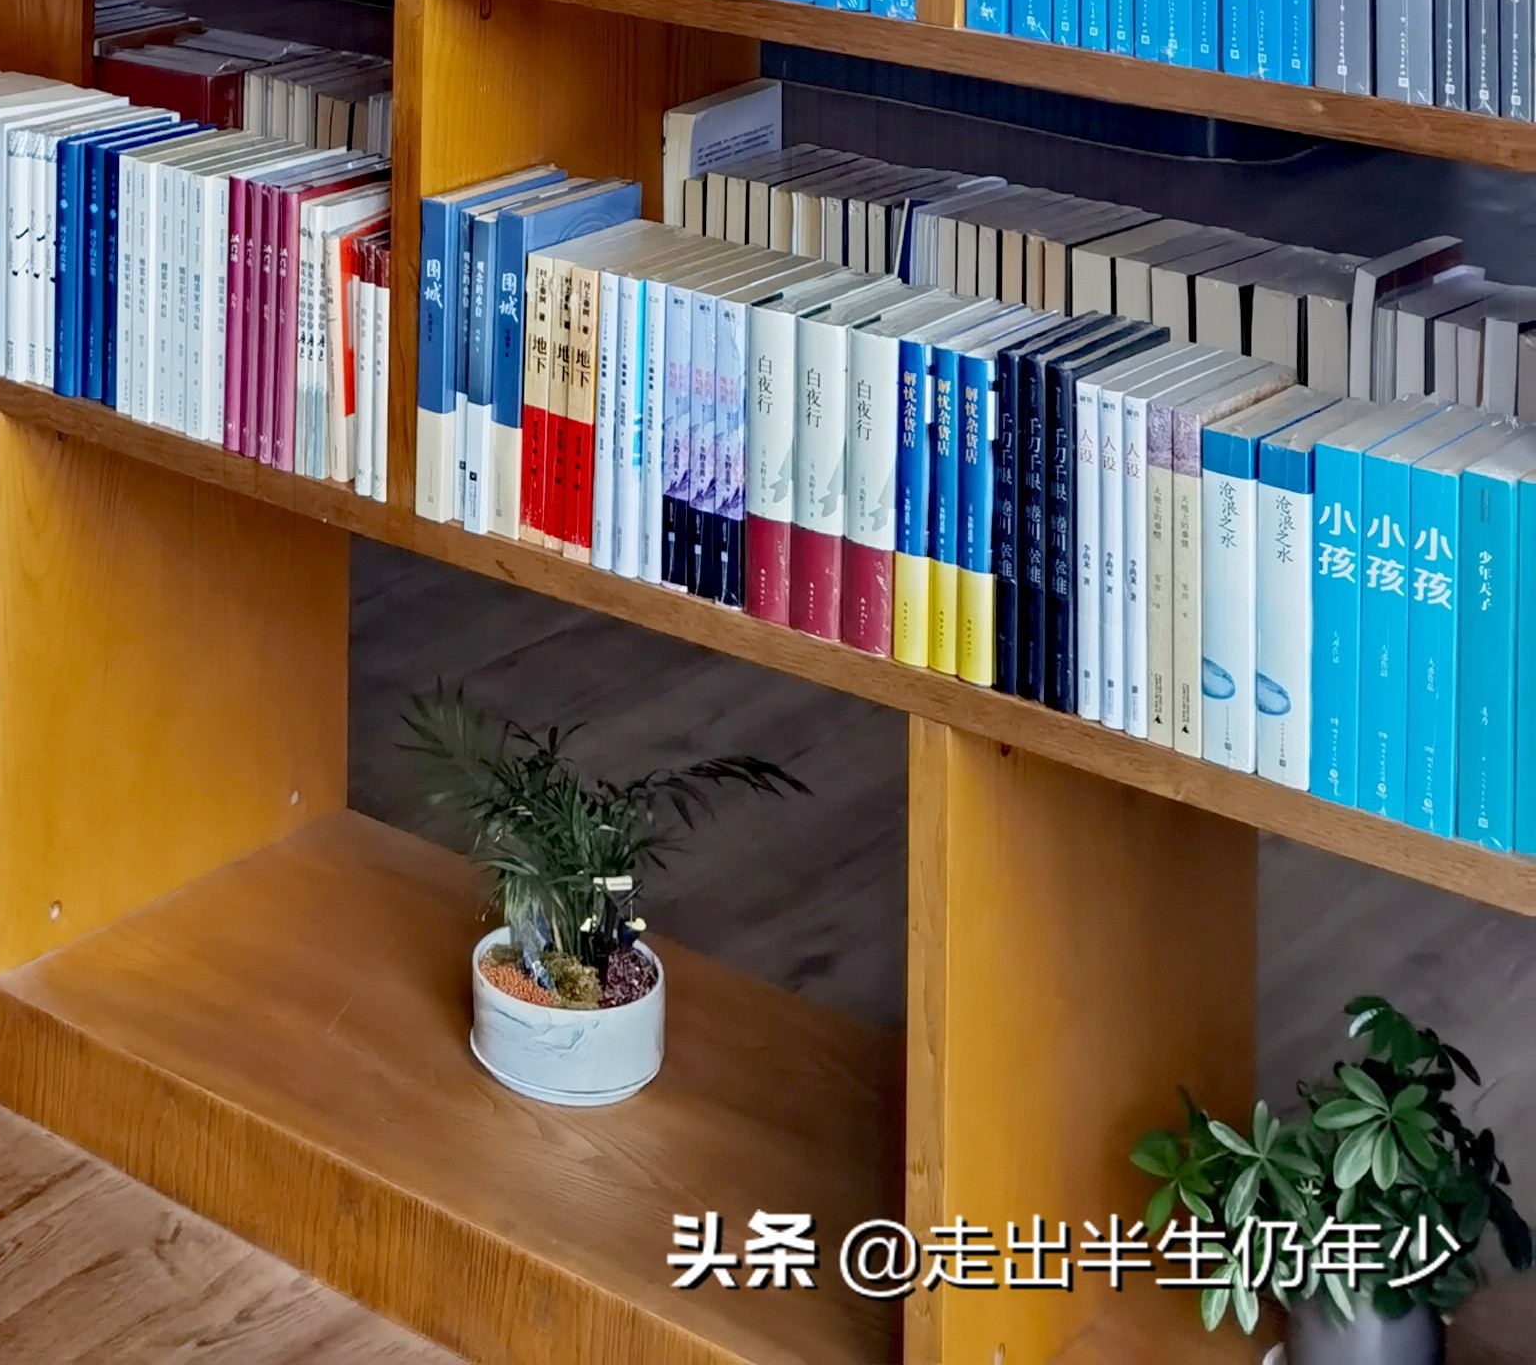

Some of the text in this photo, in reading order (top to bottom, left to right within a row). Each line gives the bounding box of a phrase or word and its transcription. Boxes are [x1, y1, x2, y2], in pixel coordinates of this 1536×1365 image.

[424, 259, 443, 309] 围城
[499, 273, 519, 322] 围城
[532, 336, 548, 374] 地下
[557, 342, 570, 383] 地下
[575, 348, 591, 389] 地下
[758, 355, 773, 415] 白夜行
[807, 368, 822, 428] 白夜行
[857, 380, 872, 441] 白夜行
[903, 371, 917, 448] 解忧杂货店
[936, 379, 951, 457] 解忧杂货店
[965, 386, 978, 465] 解忧杂货店
[1079, 428, 1094, 464] 人设
[1102, 435, 1116, 472] 人设
[1126, 442, 1141, 479] 人设
[1153, 486, 1162, 539] 大地上的事情
[1181, 495, 1190, 549] 大地上的事情
[1219, 480, 1240, 549] 沧浪之水
[1274, 494, 1296, 563] 沧浪之水
[1318, 502, 1357, 584] 小孩
[1366, 514, 1405, 597] 小孩
[1413, 527, 1453, 610] 小孩
[1478, 550, 1492, 611] 少年天子
